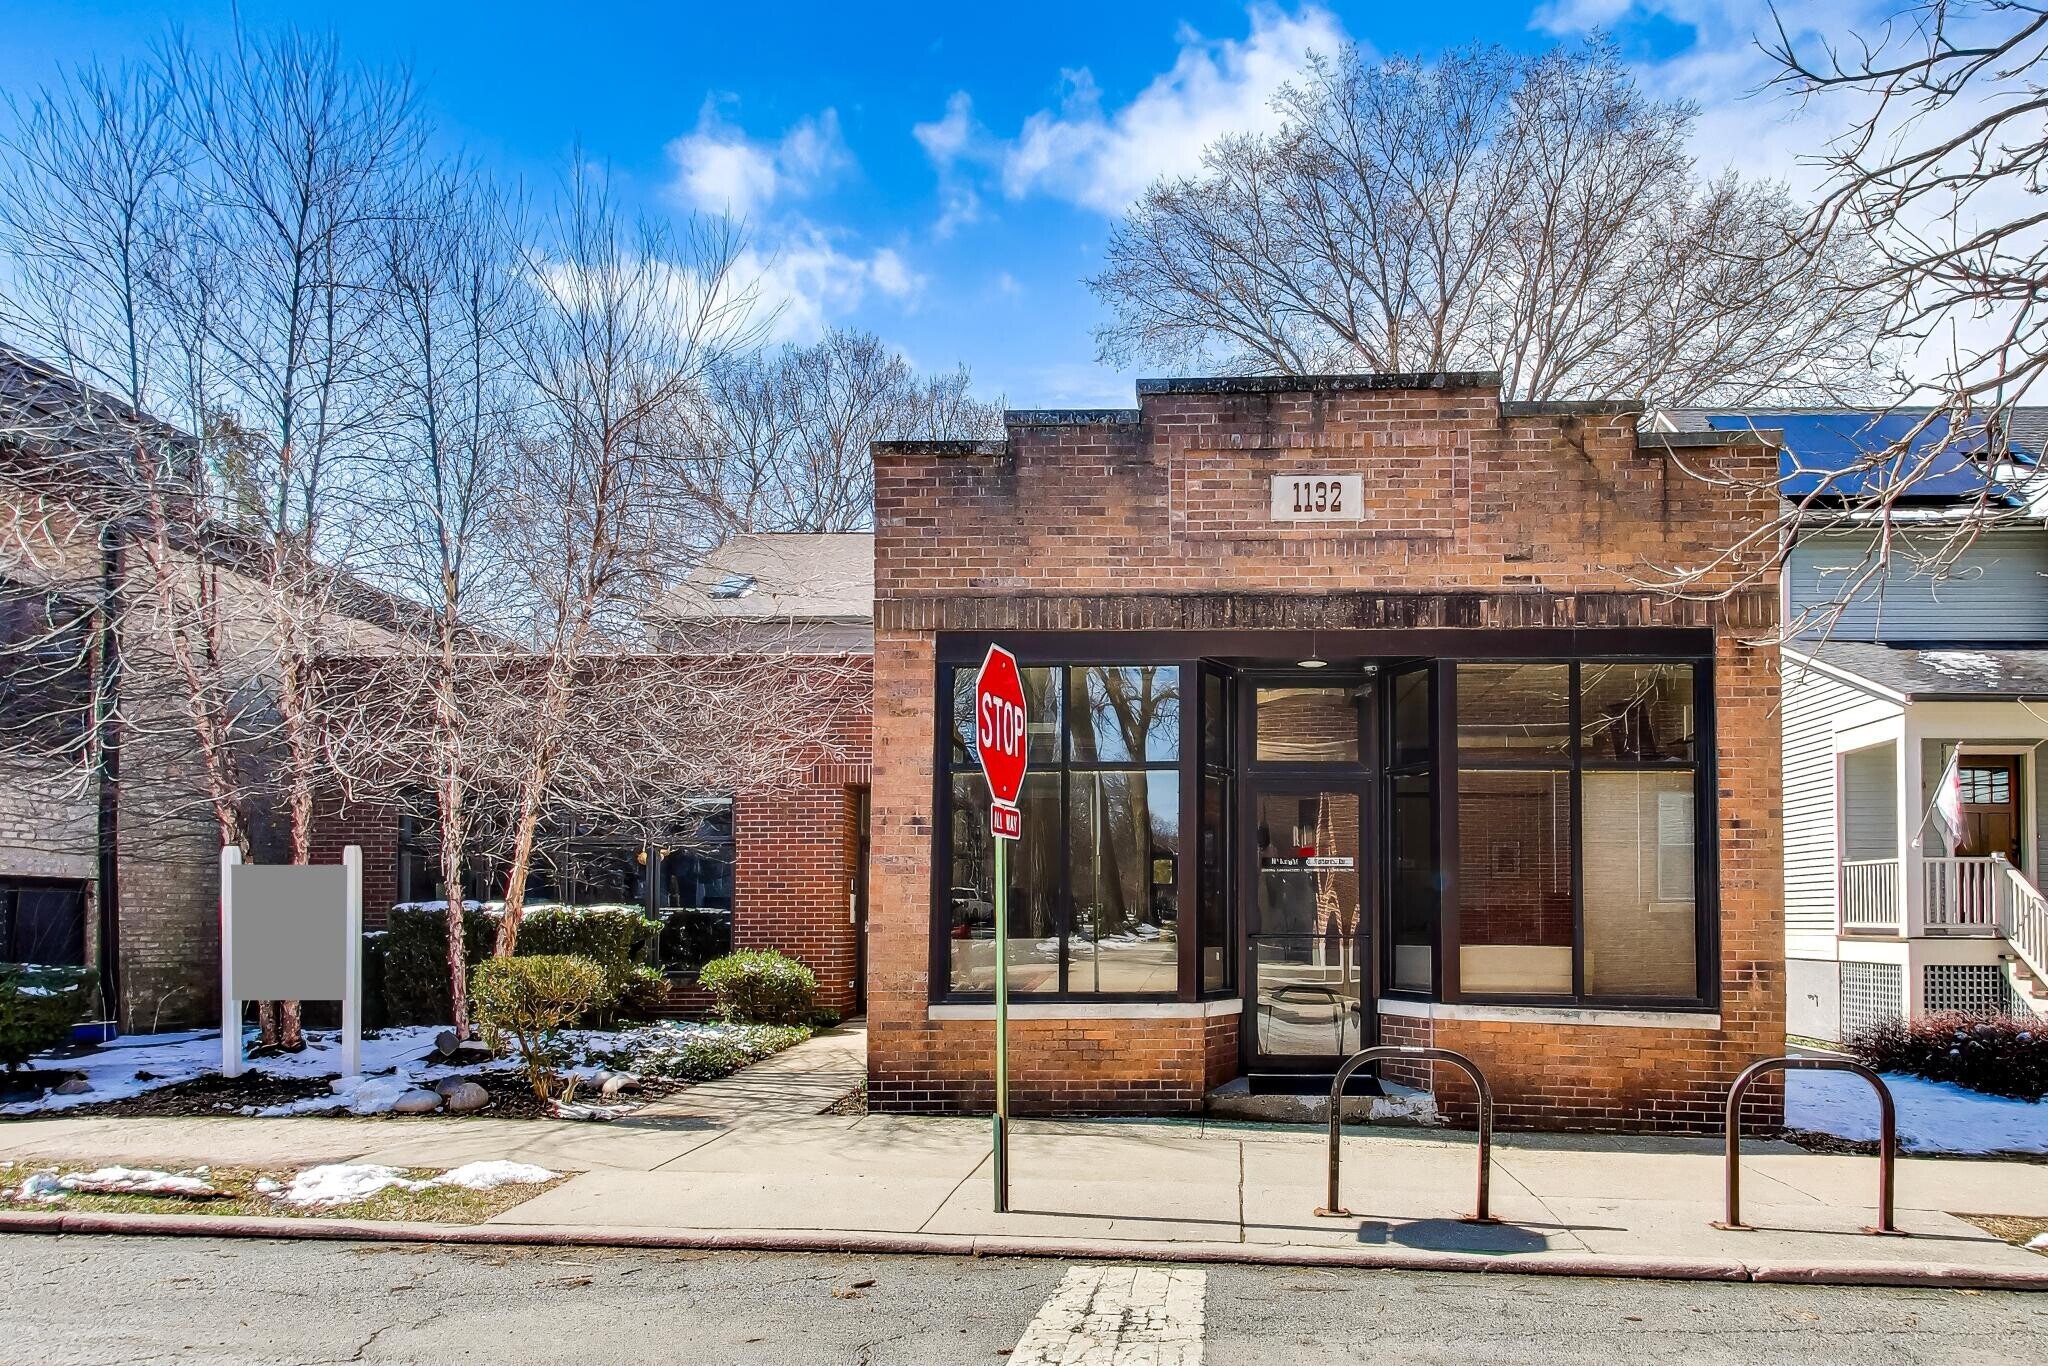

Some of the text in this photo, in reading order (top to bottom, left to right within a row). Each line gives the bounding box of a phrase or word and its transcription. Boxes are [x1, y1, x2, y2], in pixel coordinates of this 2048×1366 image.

[1293, 481, 1342, 512] 1132
[981, 691, 1024, 758] STOP
[994, 810, 1018, 833] ALL WAY
